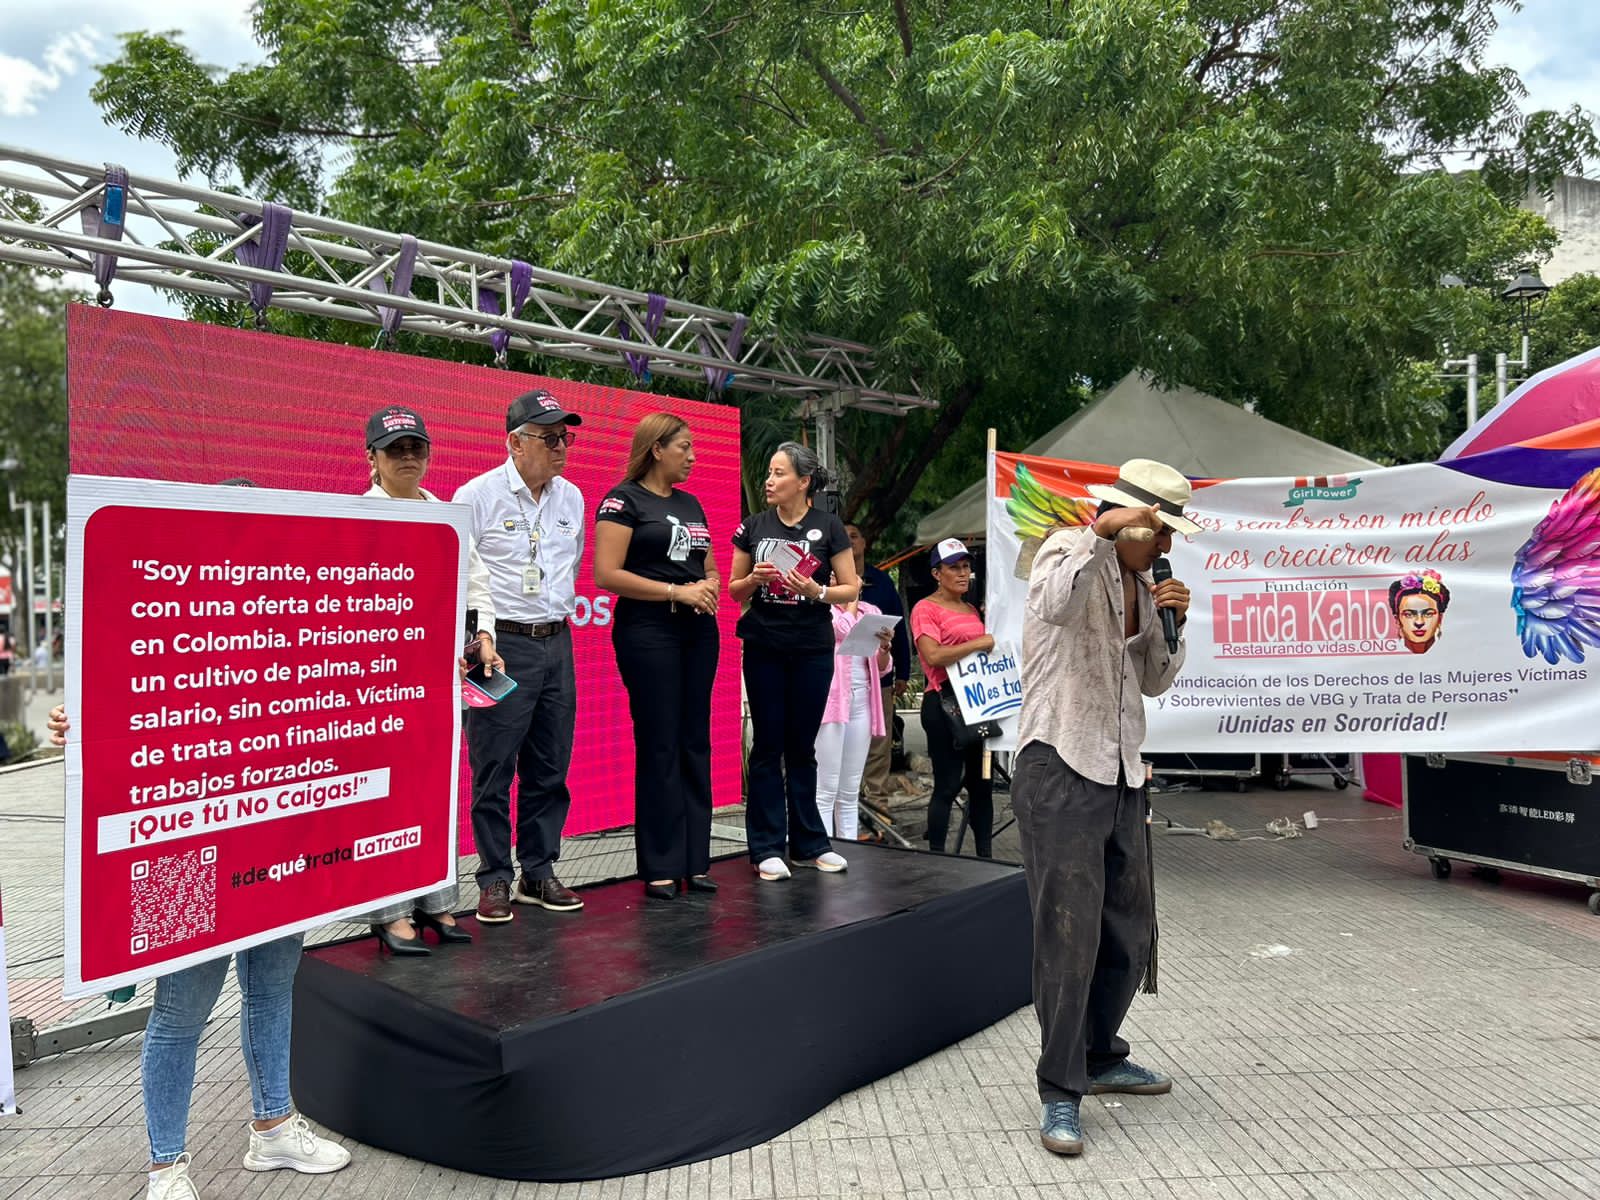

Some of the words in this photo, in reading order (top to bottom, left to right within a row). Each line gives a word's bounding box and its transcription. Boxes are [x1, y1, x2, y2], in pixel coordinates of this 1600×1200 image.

[1292, 489, 1313, 498] Girl
[1316, 489, 1352, 498] Power
[1235, 507, 1387, 531] sembraron
[1399, 491, 1495, 527] miedo
[1204, 549, 1254, 570] nos
[1263, 543, 1397, 569] crecieron
[1404, 529, 1475, 563] alas
[133, 560, 192, 586] "Soy
[200, 560, 311, 586] migrante,
[317, 562, 414, 585] engañado
[1264, 580, 1348, 592] Fundación
[131, 601, 180, 618] con
[190, 601, 235, 616] una
[242, 595, 308, 615] oferta
[315, 594, 341, 613] de
[346, 592, 413, 615] trabajo
[1227, 592, 1297, 642] Frida
[1307, 590, 1389, 641] Kahlo
[131, 639, 164, 655] en
[173, 628, 291, 653] Colombia.
[298, 625, 399, 646] Prisionero
[403, 627, 425, 640] en
[1222, 643, 1313, 655] Restaurando
[131, 675, 165, 693] un
[174, 664, 257, 689] cultivo
[264, 662, 291, 682] de
[298, 659, 365, 684] palma,
[370, 654, 397, 673] sin
[956, 661, 978, 678] La
[1262, 675, 1281, 688] de
[1286, 674, 1309, 687] los
[1314, 673, 1389, 686] Derechos
[1394, 672, 1414, 685] de
[1419, 671, 1442, 684] las
[1447, 670, 1513, 686] Mujeres
[1517, 667, 1588, 682] Víctimas
[130, 702, 222, 730] salario,
[229, 698, 261, 720] sin
[268, 690, 351, 715] comida.
[356, 683, 425, 705] Víctima
[964, 681, 986, 709] NO
[987, 687, 1000, 700] es
[1157, 695, 1166, 709] y
[1170, 694, 1281, 707] Sobrevivientes
[1286, 694, 1305, 706] de
[1310, 693, 1344, 706] VBG
[1349, 695, 1358, 709] y
[1363, 692, 1402, 705] Trata
[1406, 691, 1426, 704] de
[1217, 715, 1295, 734] ¡Unidas
[1302, 717, 1326, 733] en
[1333, 712, 1448, 733] Sororidad!
[130, 745, 165, 768] de
[172, 739, 232, 762] trata
[239, 734, 280, 752] con
[286, 716, 376, 746] finalidad
[381, 714, 404, 733] de
[129, 772, 235, 805] trabajos
[241, 757, 338, 786] forzados.
[130, 811, 194, 844] ¡Que
[203, 799, 228, 825] tú
[237, 798, 269, 818] No
